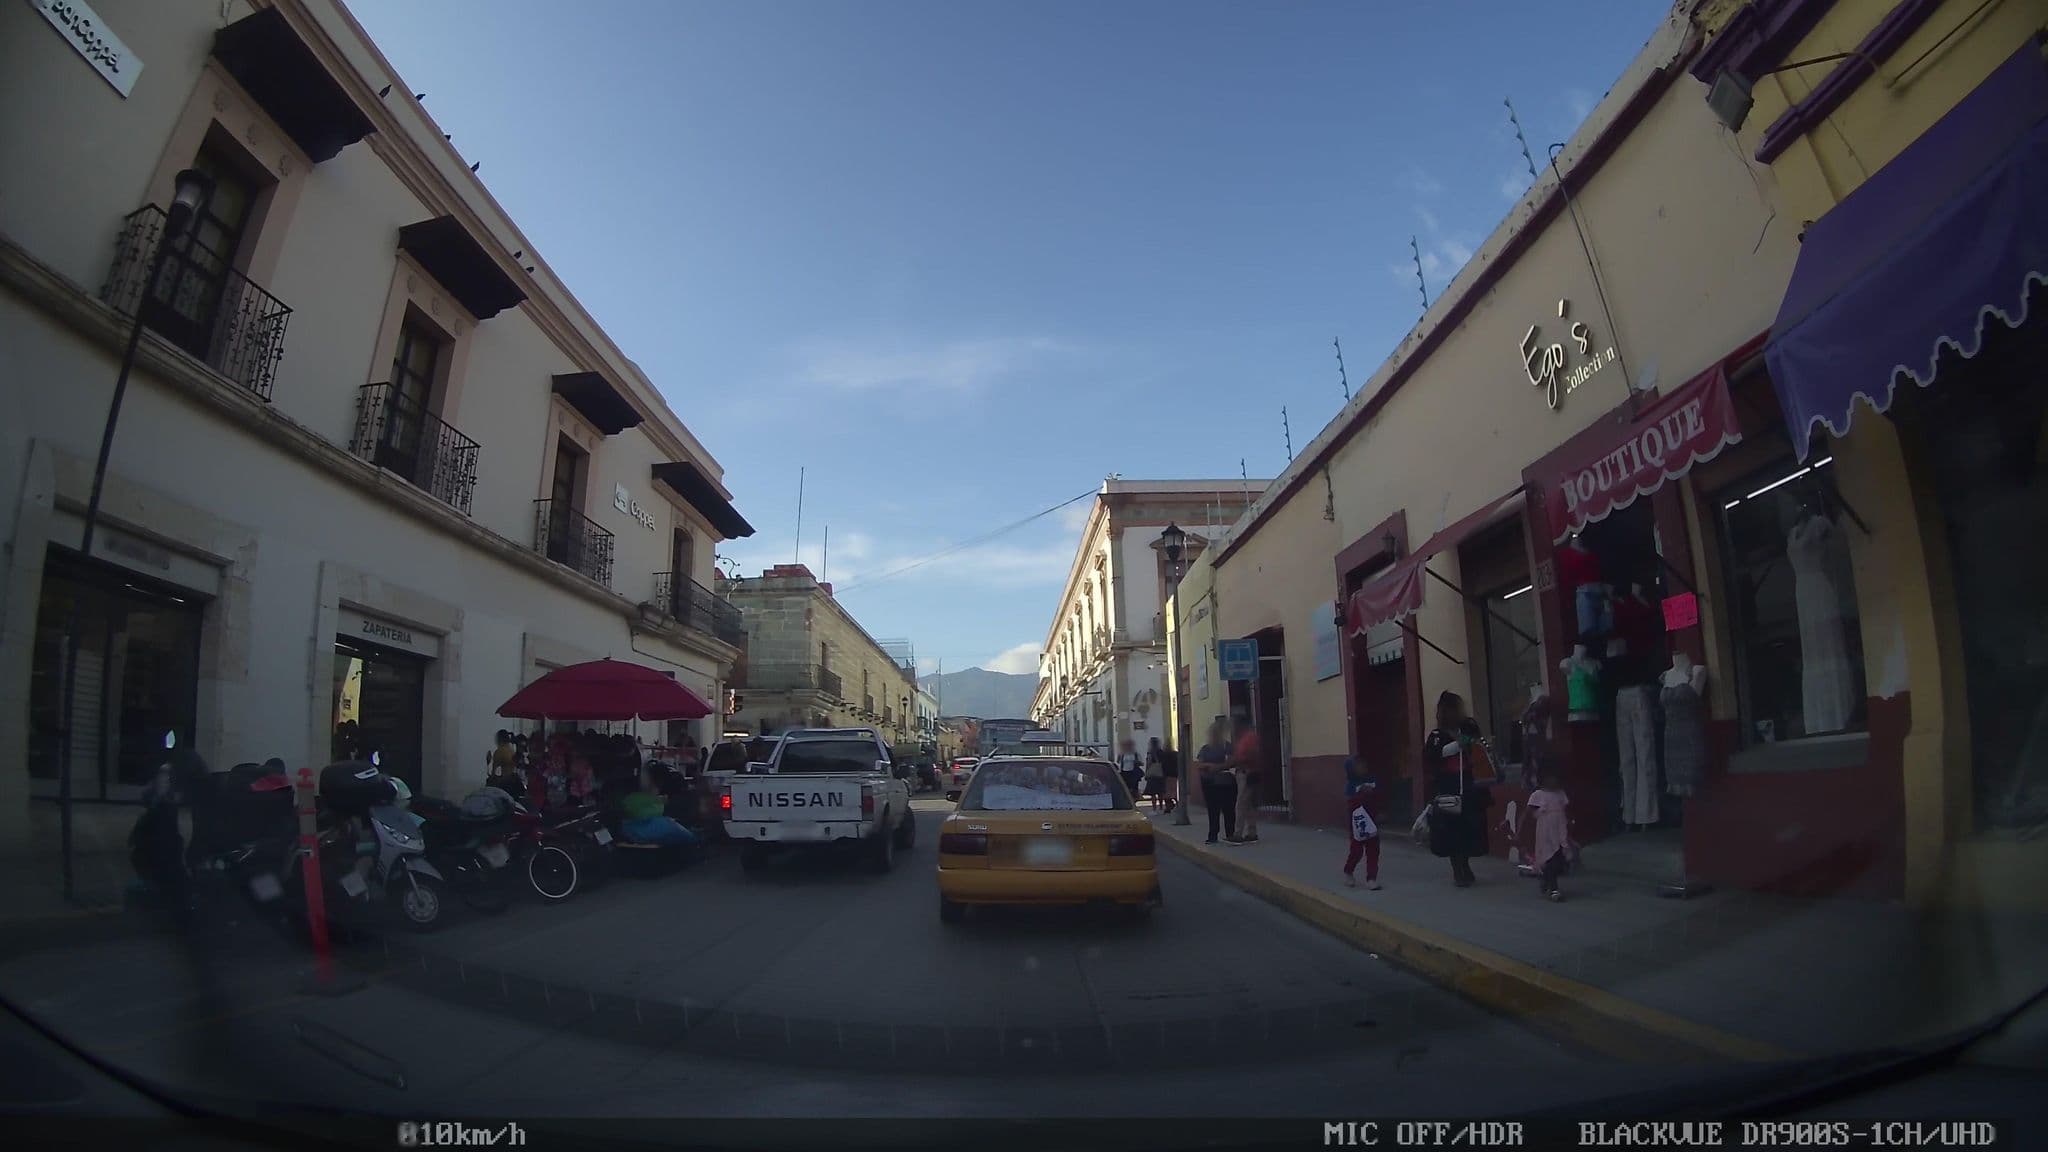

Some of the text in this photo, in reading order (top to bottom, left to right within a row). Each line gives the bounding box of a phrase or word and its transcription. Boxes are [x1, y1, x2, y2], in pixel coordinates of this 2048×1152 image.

[1519, 298, 1590, 409] Ego's
[1560, 397, 1706, 513] BOUTIQUE
[630, 499, 656, 532] Coppel
[362, 620, 412, 645] ZAPATERIA
[748, 792, 844, 808] NISSAN
